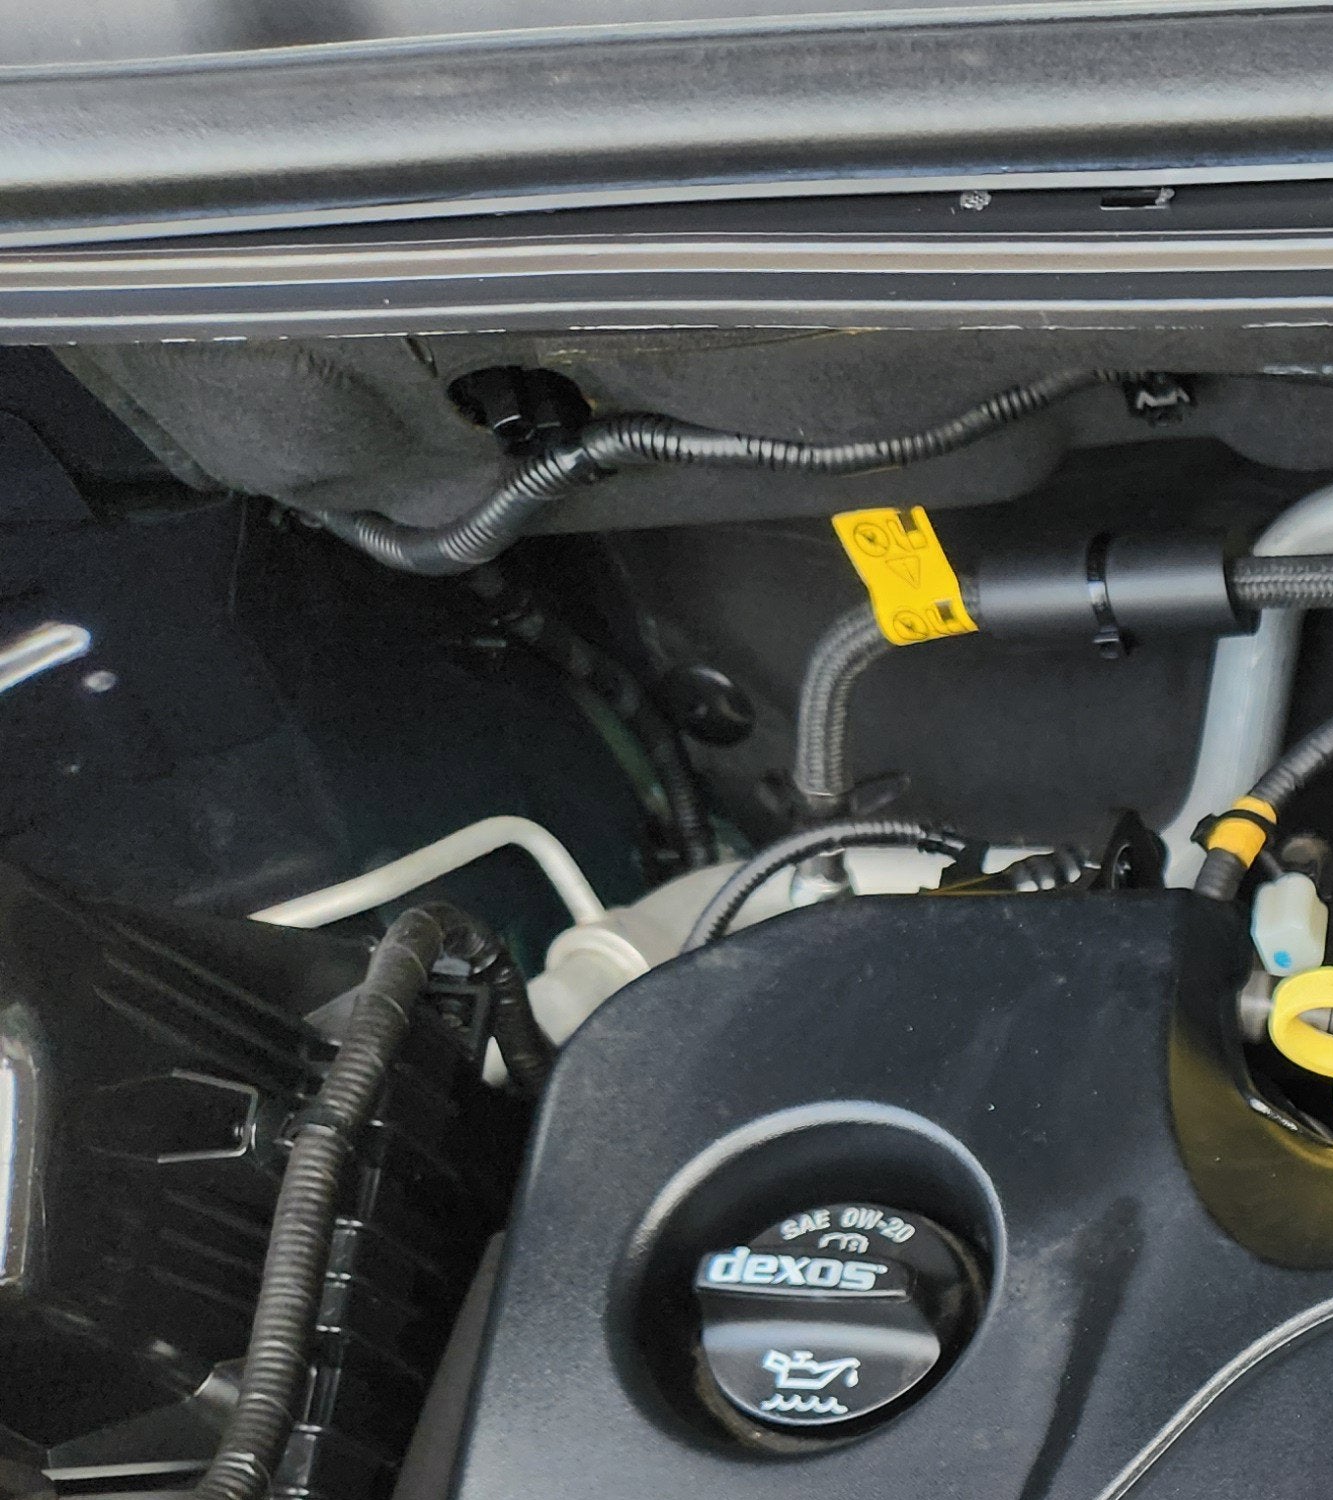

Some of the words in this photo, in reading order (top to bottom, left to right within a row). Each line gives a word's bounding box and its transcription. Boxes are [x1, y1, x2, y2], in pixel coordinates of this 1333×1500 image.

[780, 1208, 831, 1241] SAE
[840, 1207, 917, 1244] 0W-20
[707, 1245, 879, 1292] dexos
